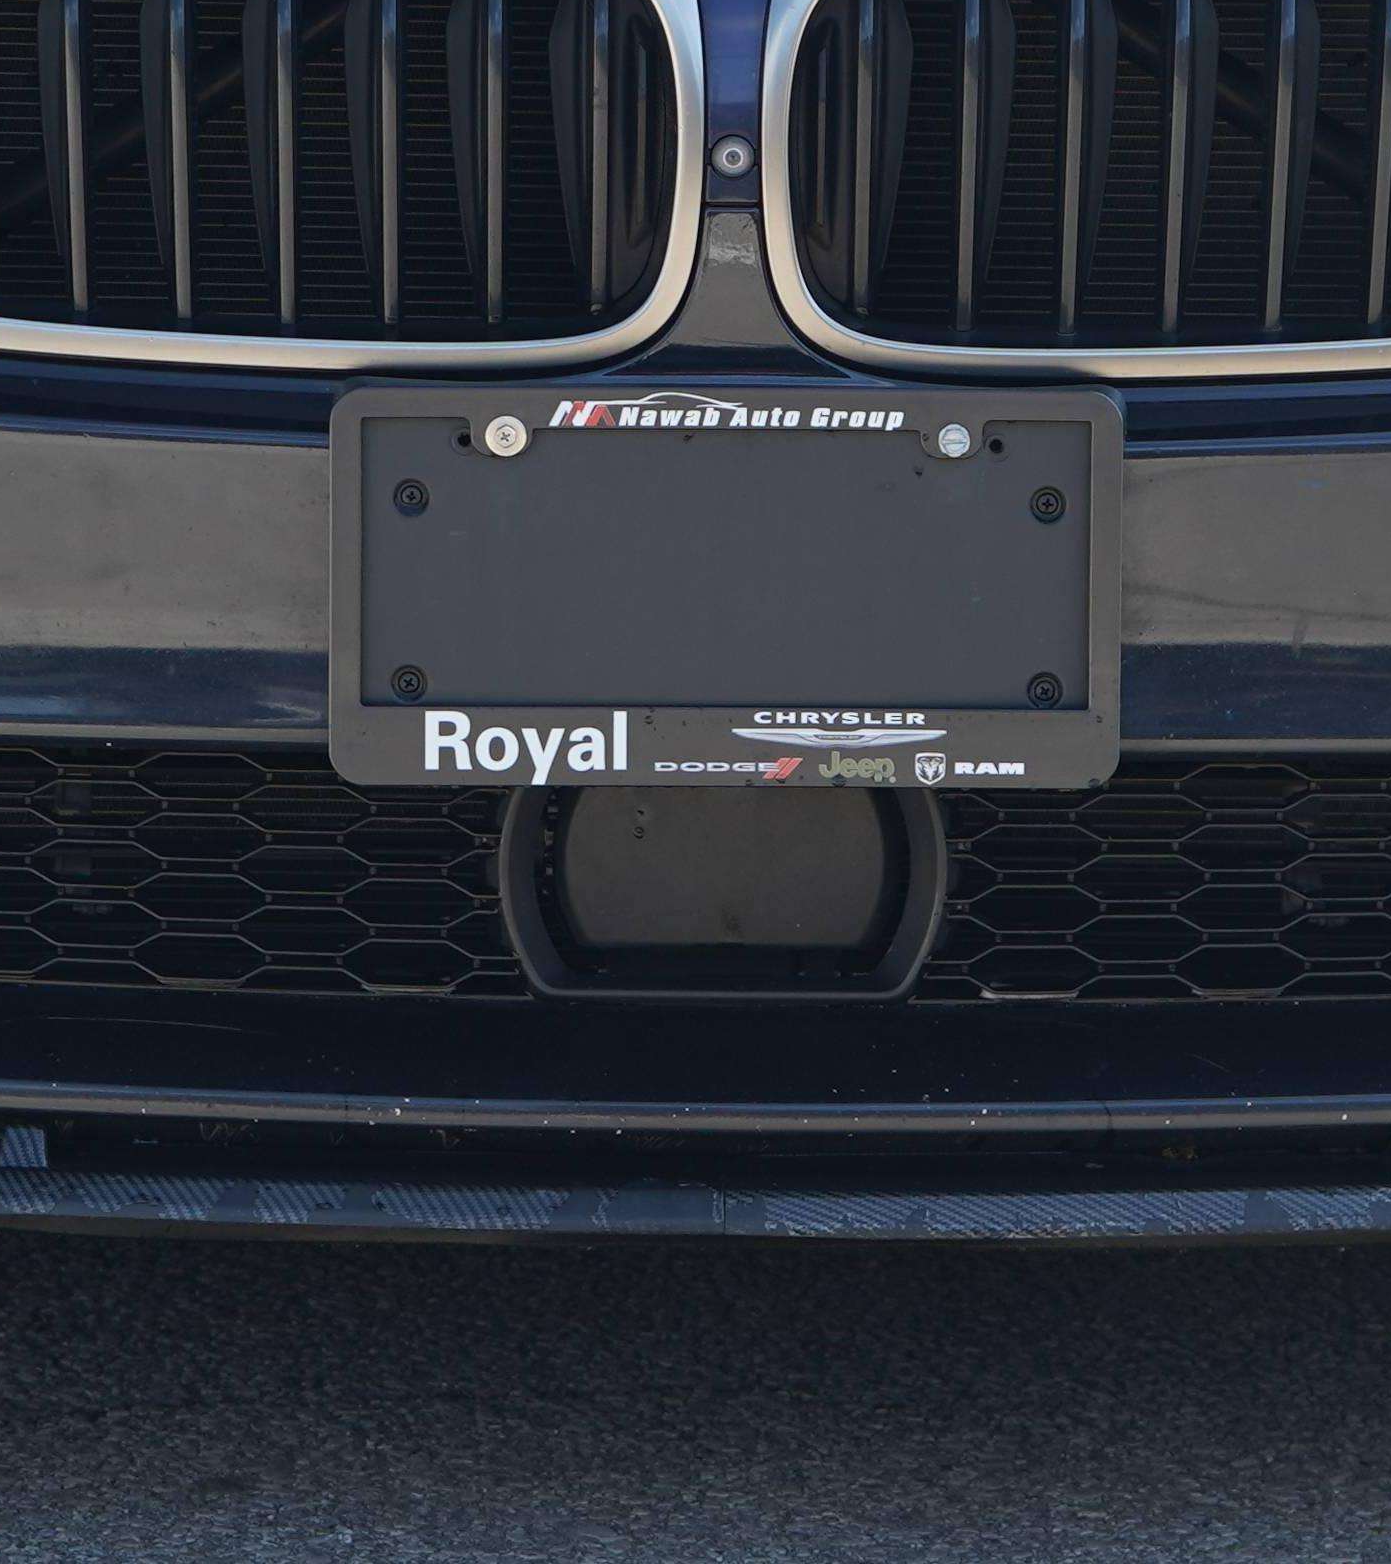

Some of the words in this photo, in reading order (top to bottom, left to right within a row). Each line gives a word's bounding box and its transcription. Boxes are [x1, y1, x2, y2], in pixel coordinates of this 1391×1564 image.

[619, 405, 720, 427] Nawab
[729, 405, 801, 427] Auto
[810, 407, 904, 431] Group
[753, 711, 926, 726] CHRYSLER
[424, 710, 628, 786] Royal
[654, 761, 779, 773] DODGE
[818, 750, 896, 783] Jeep
[954, 762, 1025, 776] RAM
